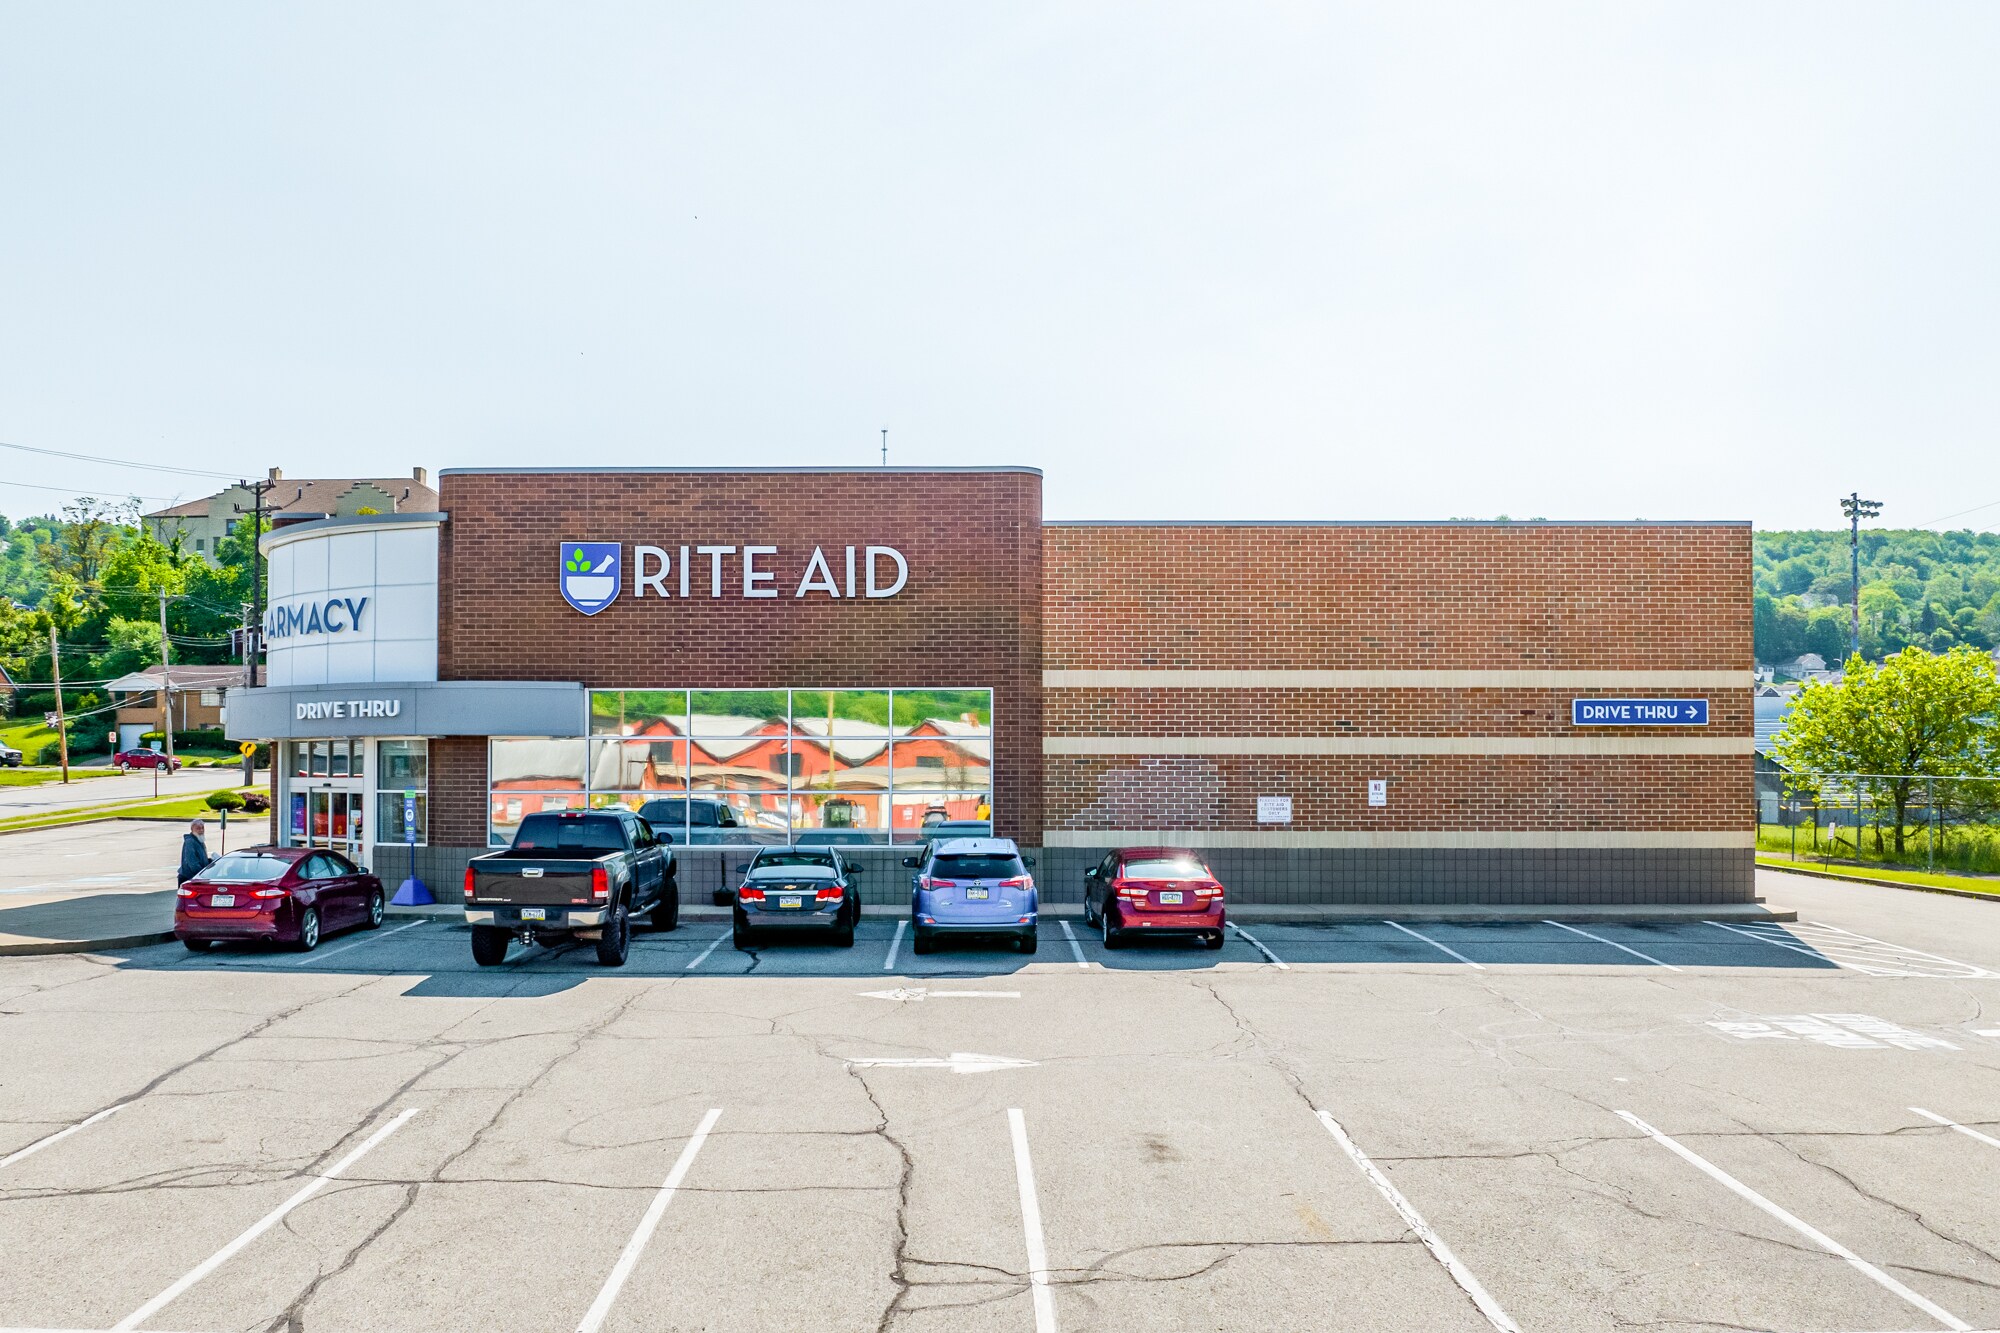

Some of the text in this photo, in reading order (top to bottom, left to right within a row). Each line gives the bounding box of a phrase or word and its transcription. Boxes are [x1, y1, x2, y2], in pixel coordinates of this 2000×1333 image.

[634, 545, 909, 598] RITE AID
[264, 597, 367, 640] ARMACY
[296, 700, 400, 720] DRIVE THRU
[1583, 705, 1678, 719] DRIVE THRU
